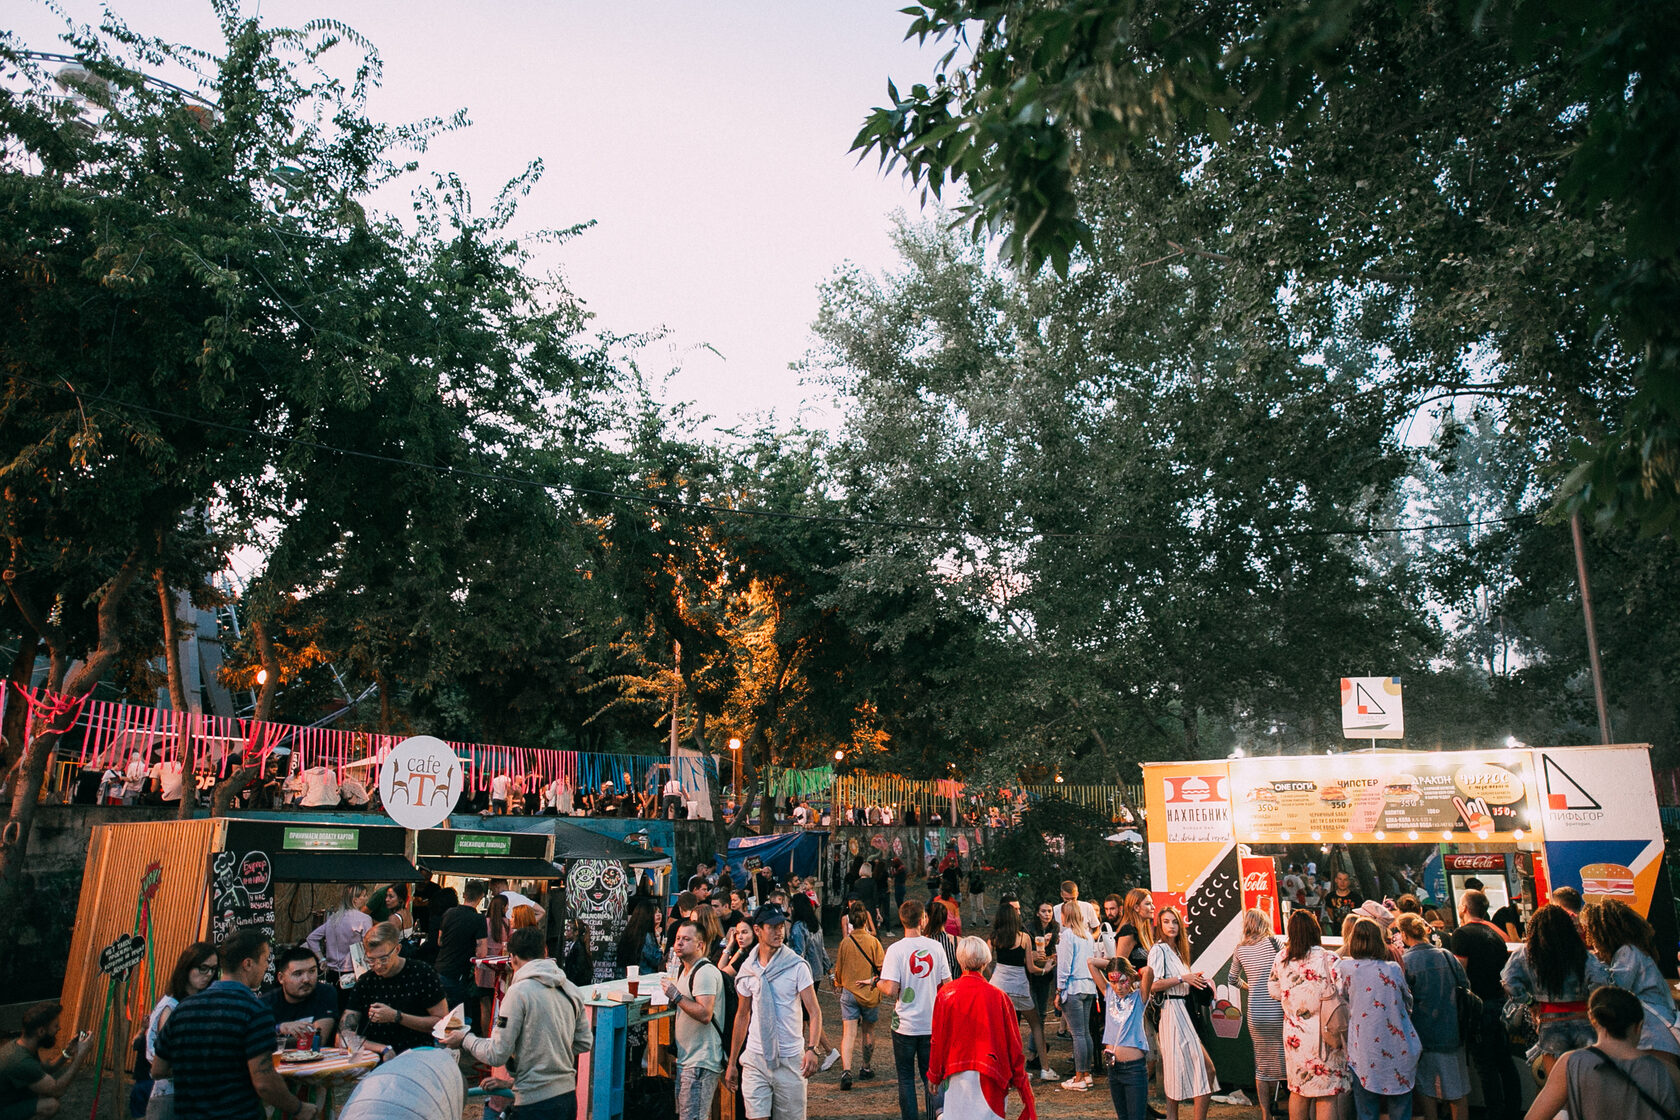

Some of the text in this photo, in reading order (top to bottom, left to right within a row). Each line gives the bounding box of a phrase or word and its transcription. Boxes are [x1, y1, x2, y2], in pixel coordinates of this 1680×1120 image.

[407, 755, 441, 774] cafe
[1337, 778, 1379, 788] ЧИПСТЕР
[1167, 808, 1229, 822] НАХЛЕБНИК
[1454, 855, 1494, 869] Coca-Cola
[1243, 871, 1269, 892] Cola
